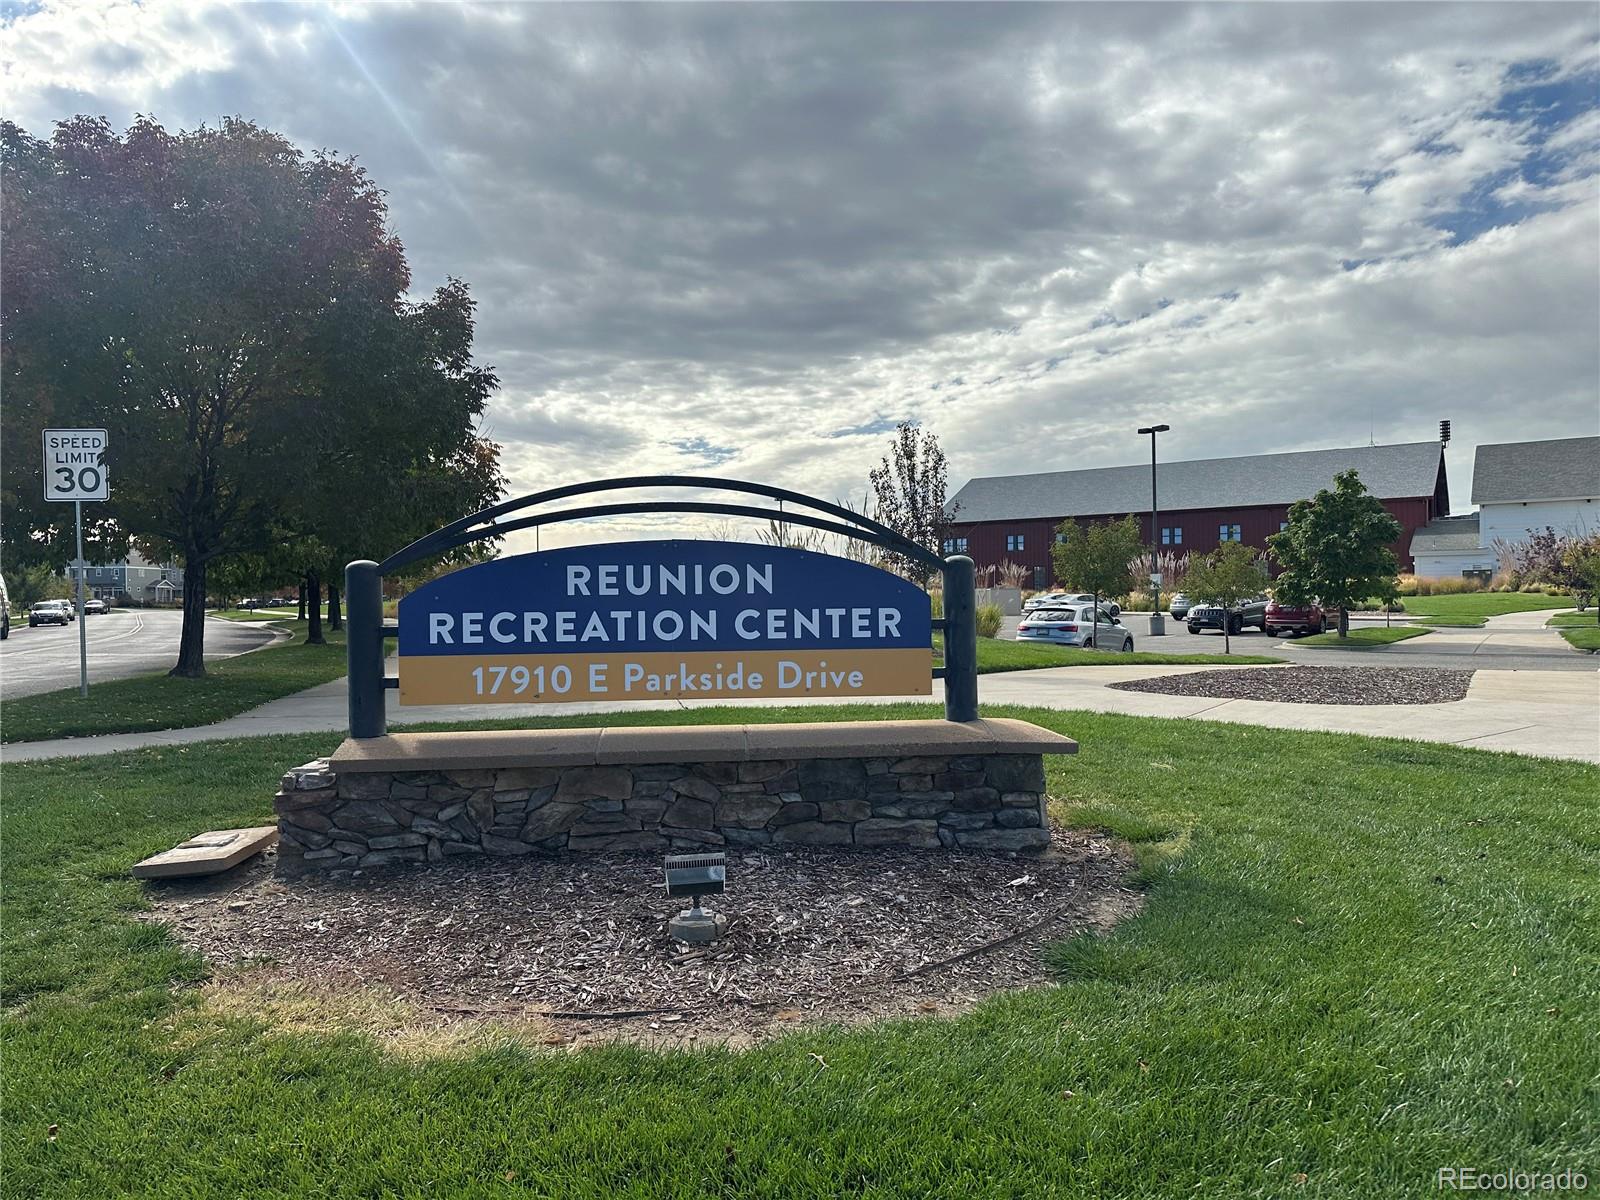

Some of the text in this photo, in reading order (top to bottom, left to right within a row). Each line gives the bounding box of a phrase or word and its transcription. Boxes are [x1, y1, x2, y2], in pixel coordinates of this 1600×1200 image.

[50, 437, 101, 448] SPEED
[55, 452, 96, 464] LIMIT
[54, 467, 100, 493] 30
[566, 563, 774, 597] REUNION
[428, 607, 902, 645] RECREATION CENTER
[471, 660, 865, 696] 17910 E Parkside Drive
